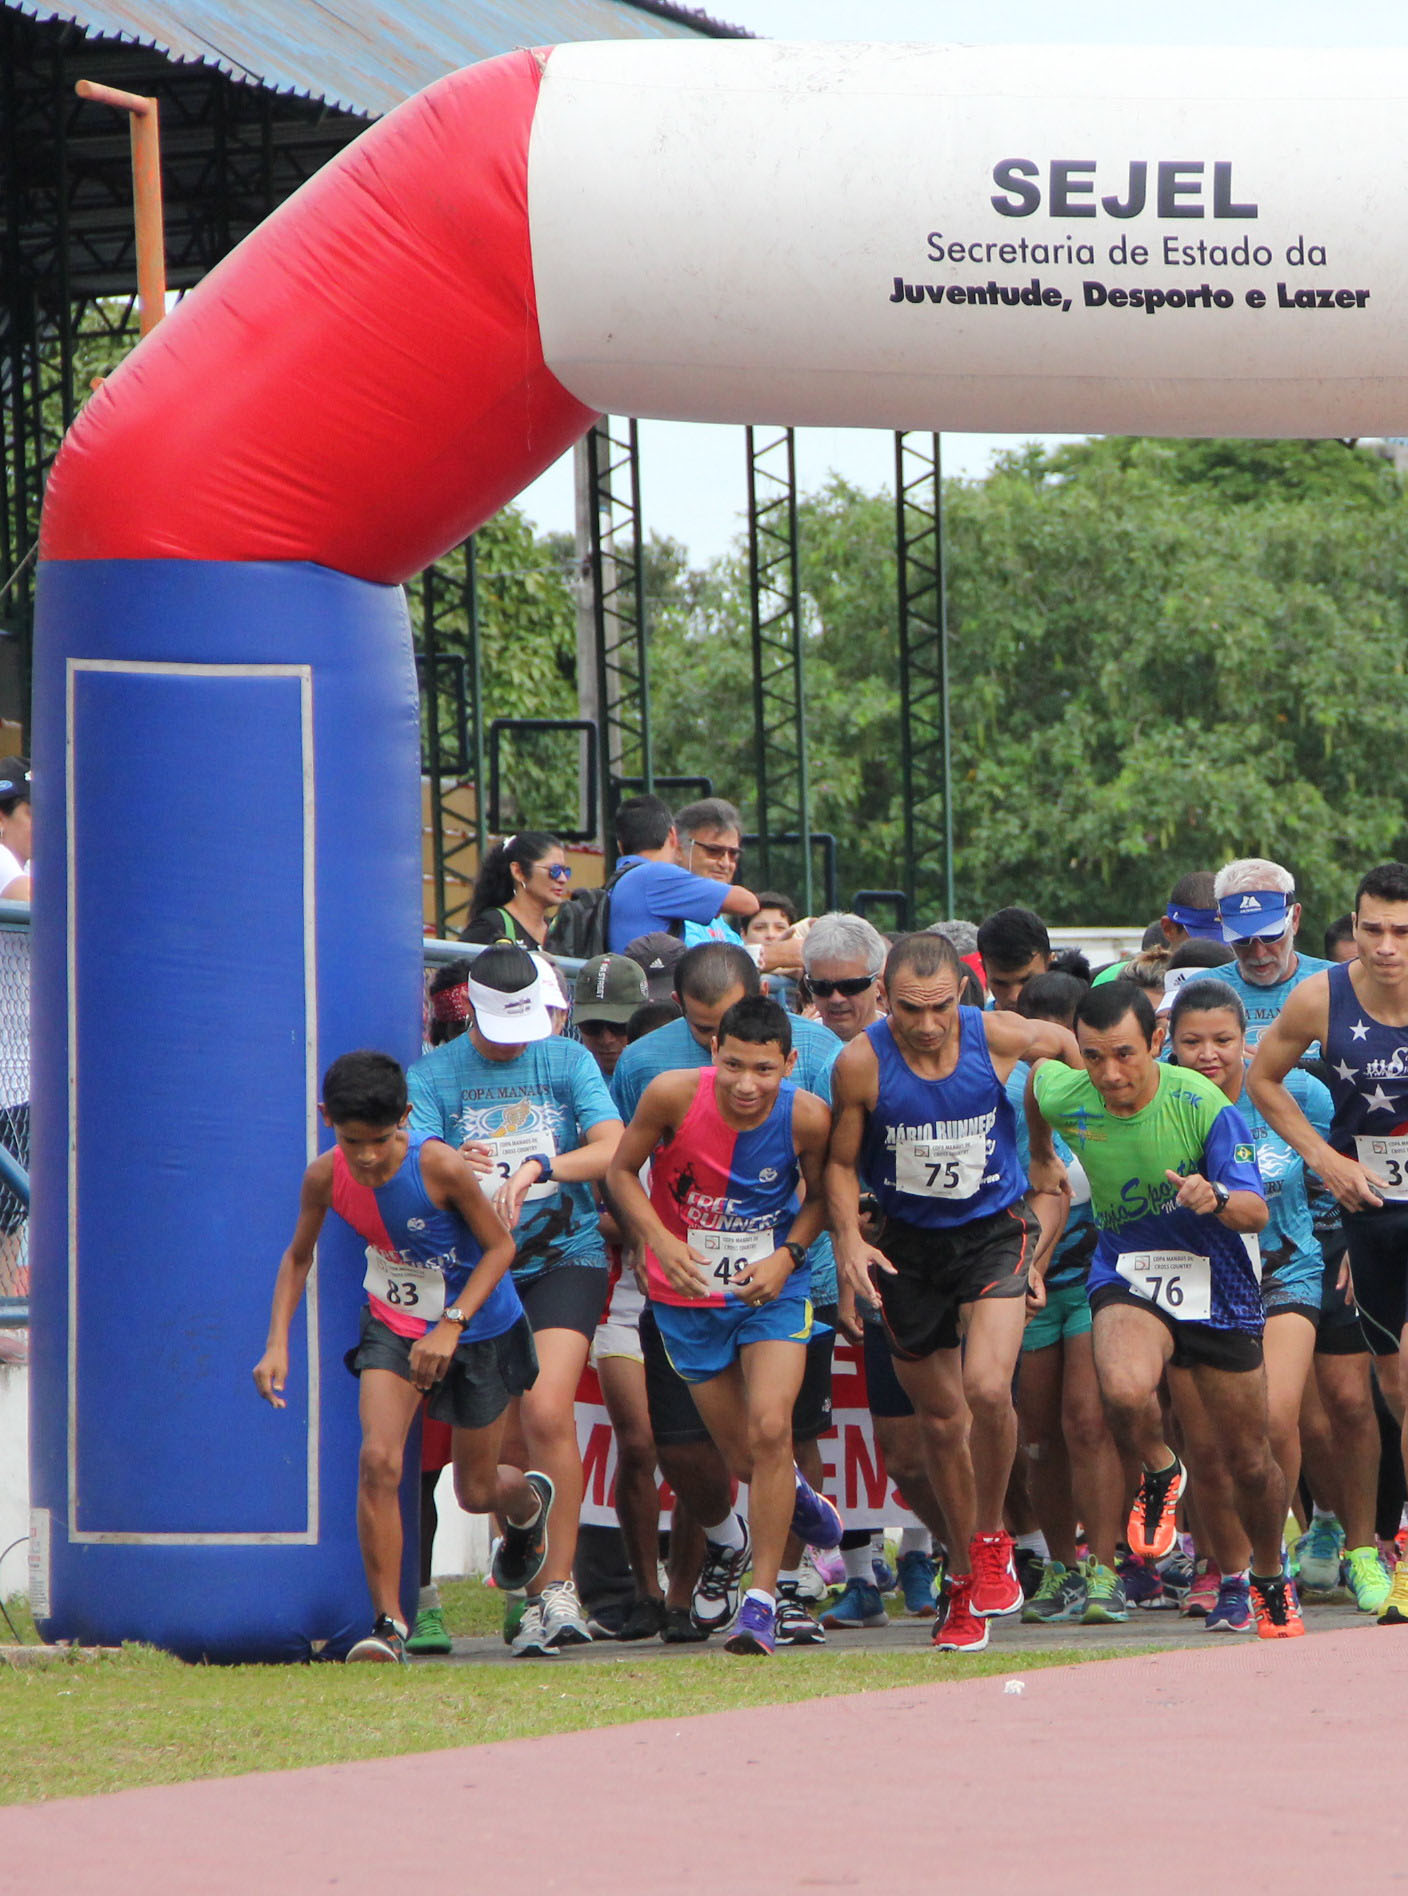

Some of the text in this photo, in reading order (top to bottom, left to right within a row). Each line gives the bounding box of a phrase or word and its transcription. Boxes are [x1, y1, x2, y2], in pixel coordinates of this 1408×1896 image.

[990, 157, 1258, 219] SEJEL
[926, 231, 1327, 267] Secretaria de Estado da
[889, 277, 1370, 314] Juventude, Desporto e Lazer
[462, 1084, 550, 1100] COPA MANAUS
[924, 1161, 960, 1188] 75
[687, 1191, 742, 1216] FREE
[386, 1279, 419, 1306] 83
[1144, 1275, 1184, 1307] 76
